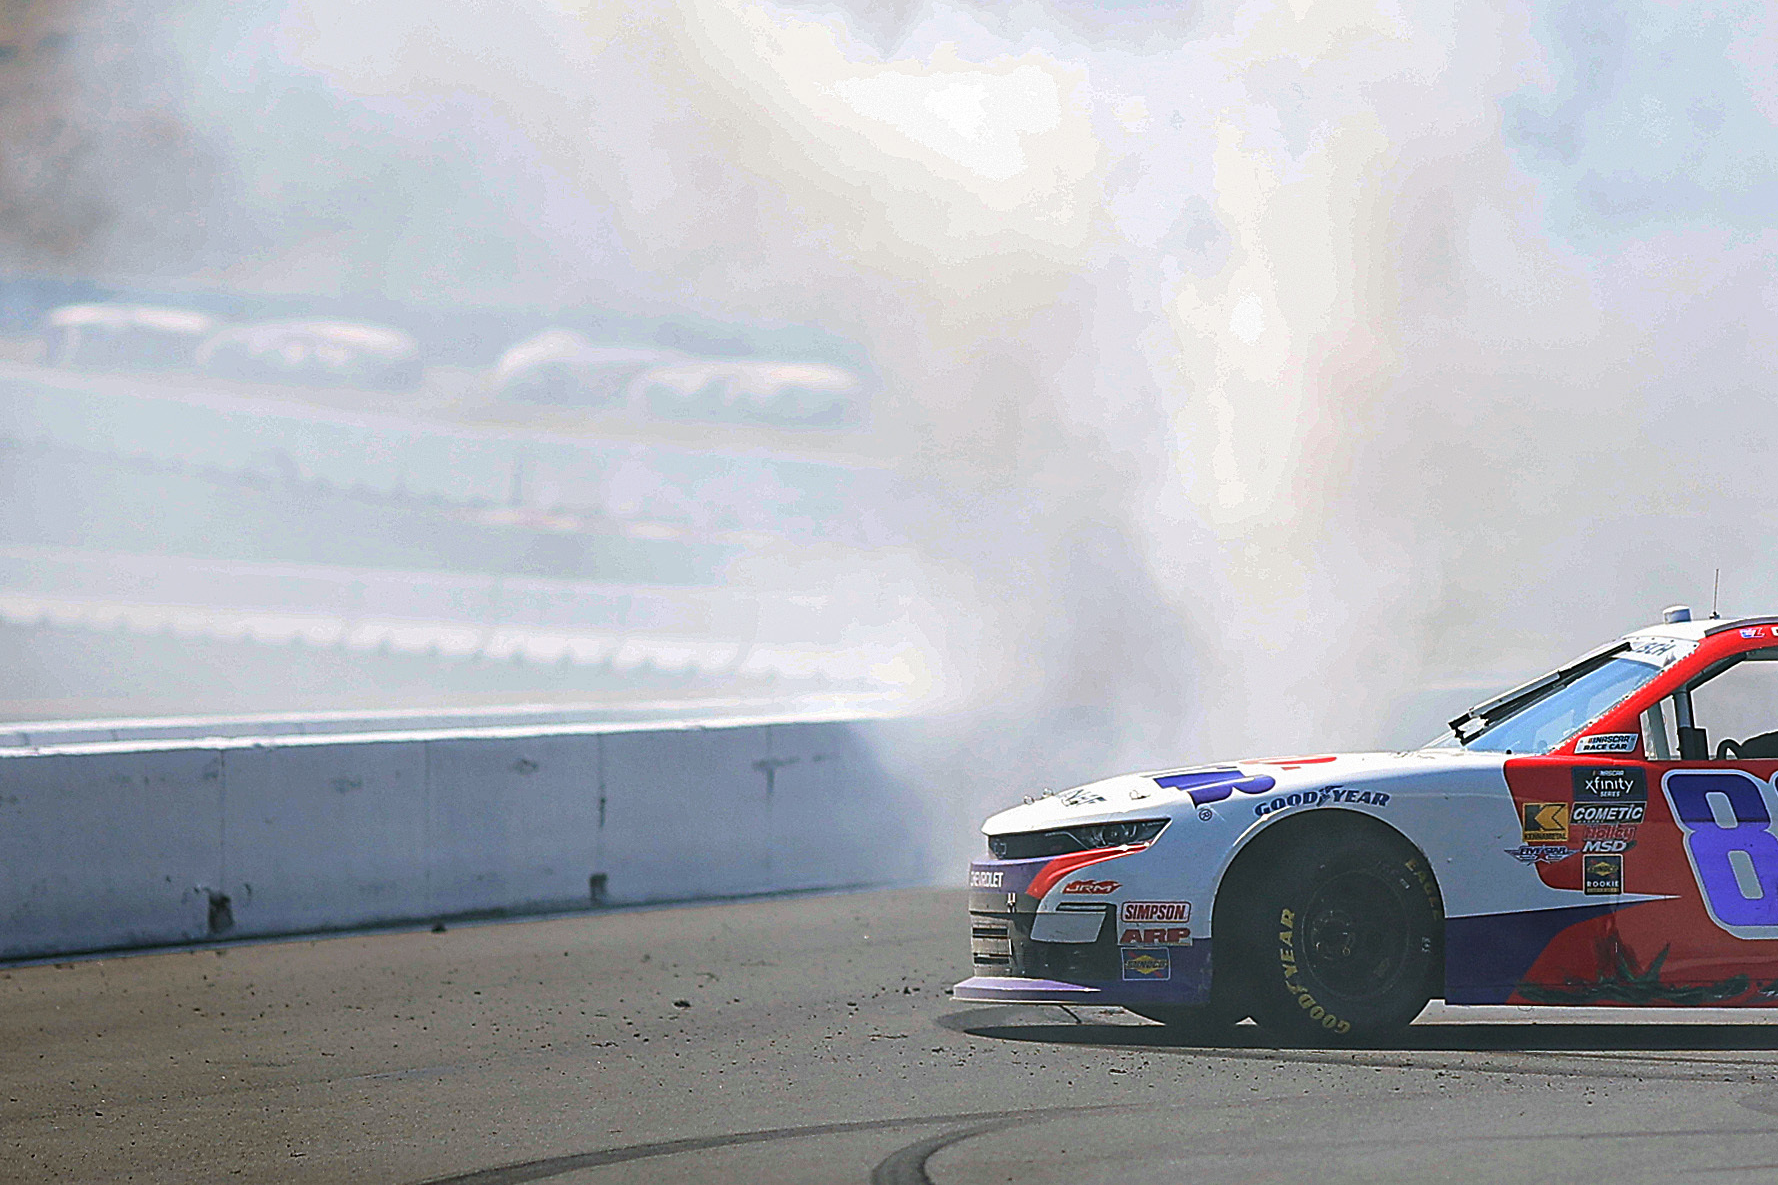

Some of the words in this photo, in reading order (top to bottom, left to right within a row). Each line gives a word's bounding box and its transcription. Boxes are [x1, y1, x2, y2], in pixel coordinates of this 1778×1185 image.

[1590, 736, 1630, 744] NASCAR
[1585, 777, 1634, 794] xfinity
[1573, 804, 1643, 820] COMETIC
[1582, 840, 1627, 852] MSD
[1125, 904, 1186, 920] SIMPSON
[1120, 928, 1191, 943] ARP
